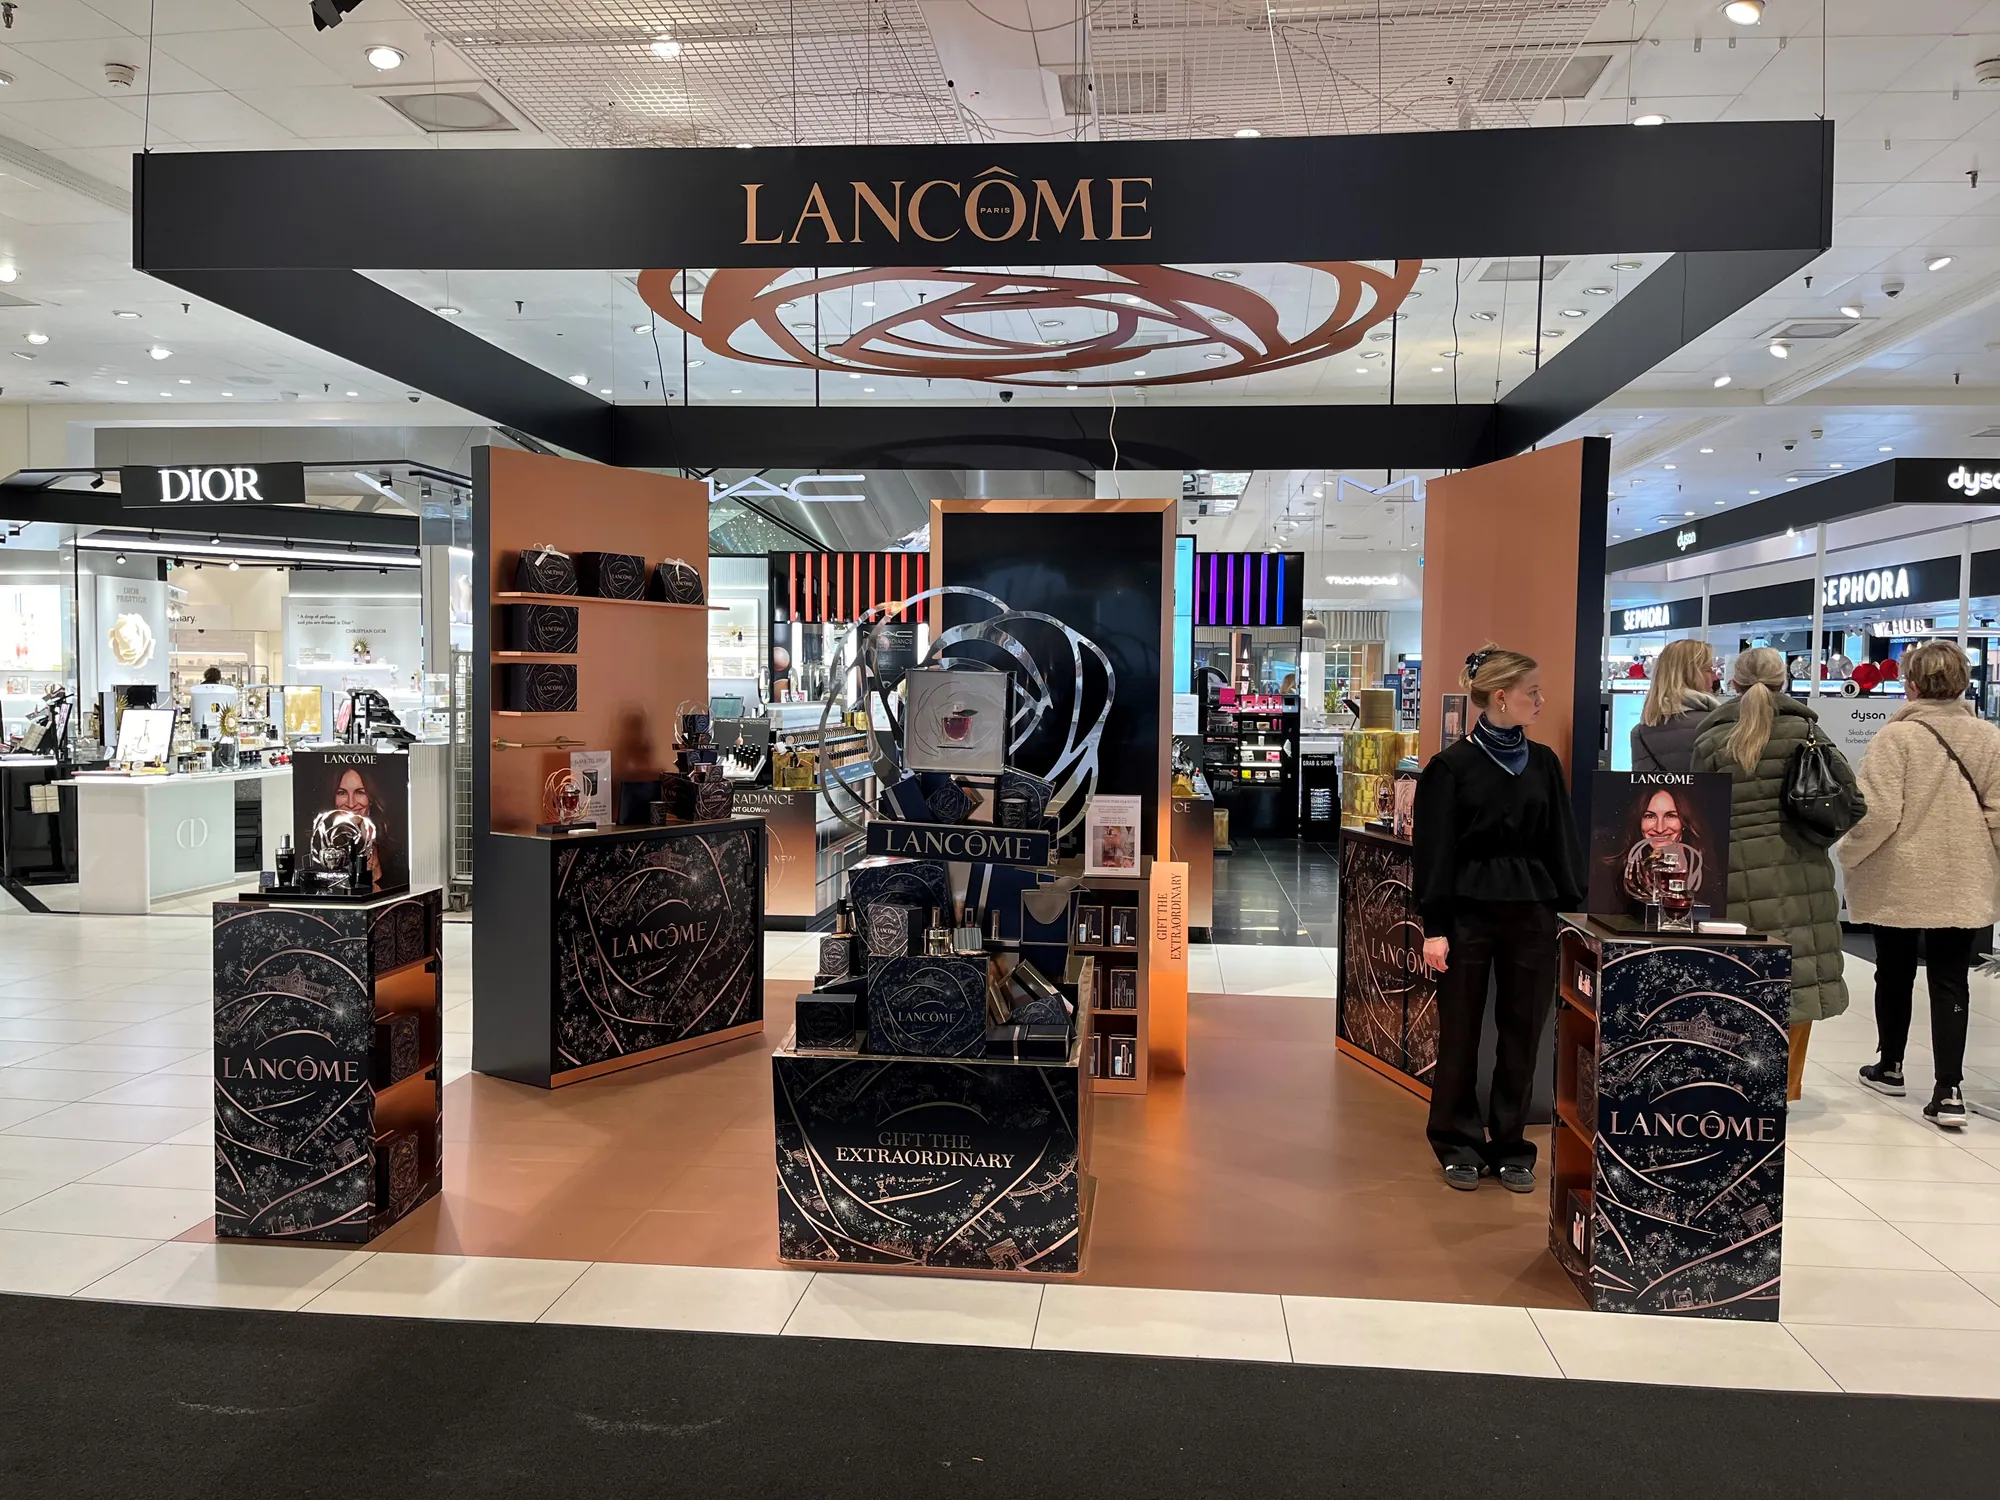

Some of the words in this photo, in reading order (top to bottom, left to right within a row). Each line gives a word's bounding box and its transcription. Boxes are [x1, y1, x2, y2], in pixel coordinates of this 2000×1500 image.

[739, 165, 1153, 245] LANCÔME
[158, 467, 264, 502] DIOR
[1677, 530, 1696, 551] dyson
[1624, 605, 1670, 631] SEPHORA
[1851, 709, 1886, 722] dyson
[324, 753, 377, 765] LANCÔME
[1630, 772, 1694, 785] LANCÔME
[733, 794, 795, 805] RADIANCE
[886, 829, 1031, 861] LANCÔME
[774, 854, 796, 863] NEW
[1157, 893, 1168, 913] THE
[1156, 916, 1168, 940] GIFT
[1171, 873, 1181, 960] EXTRAORDINARY
[612, 921, 707, 959] LANCÔME
[898, 1010, 957, 1024] LANCÔME
[222, 1055, 359, 1083] LANCÔME
[1609, 1110, 1776, 1142] LANCÔME
[878, 1131, 925, 1147] GIFT
[929, 1133, 971, 1149] THE
[836, 1146, 1015, 1169] EXTRAORDINARY
